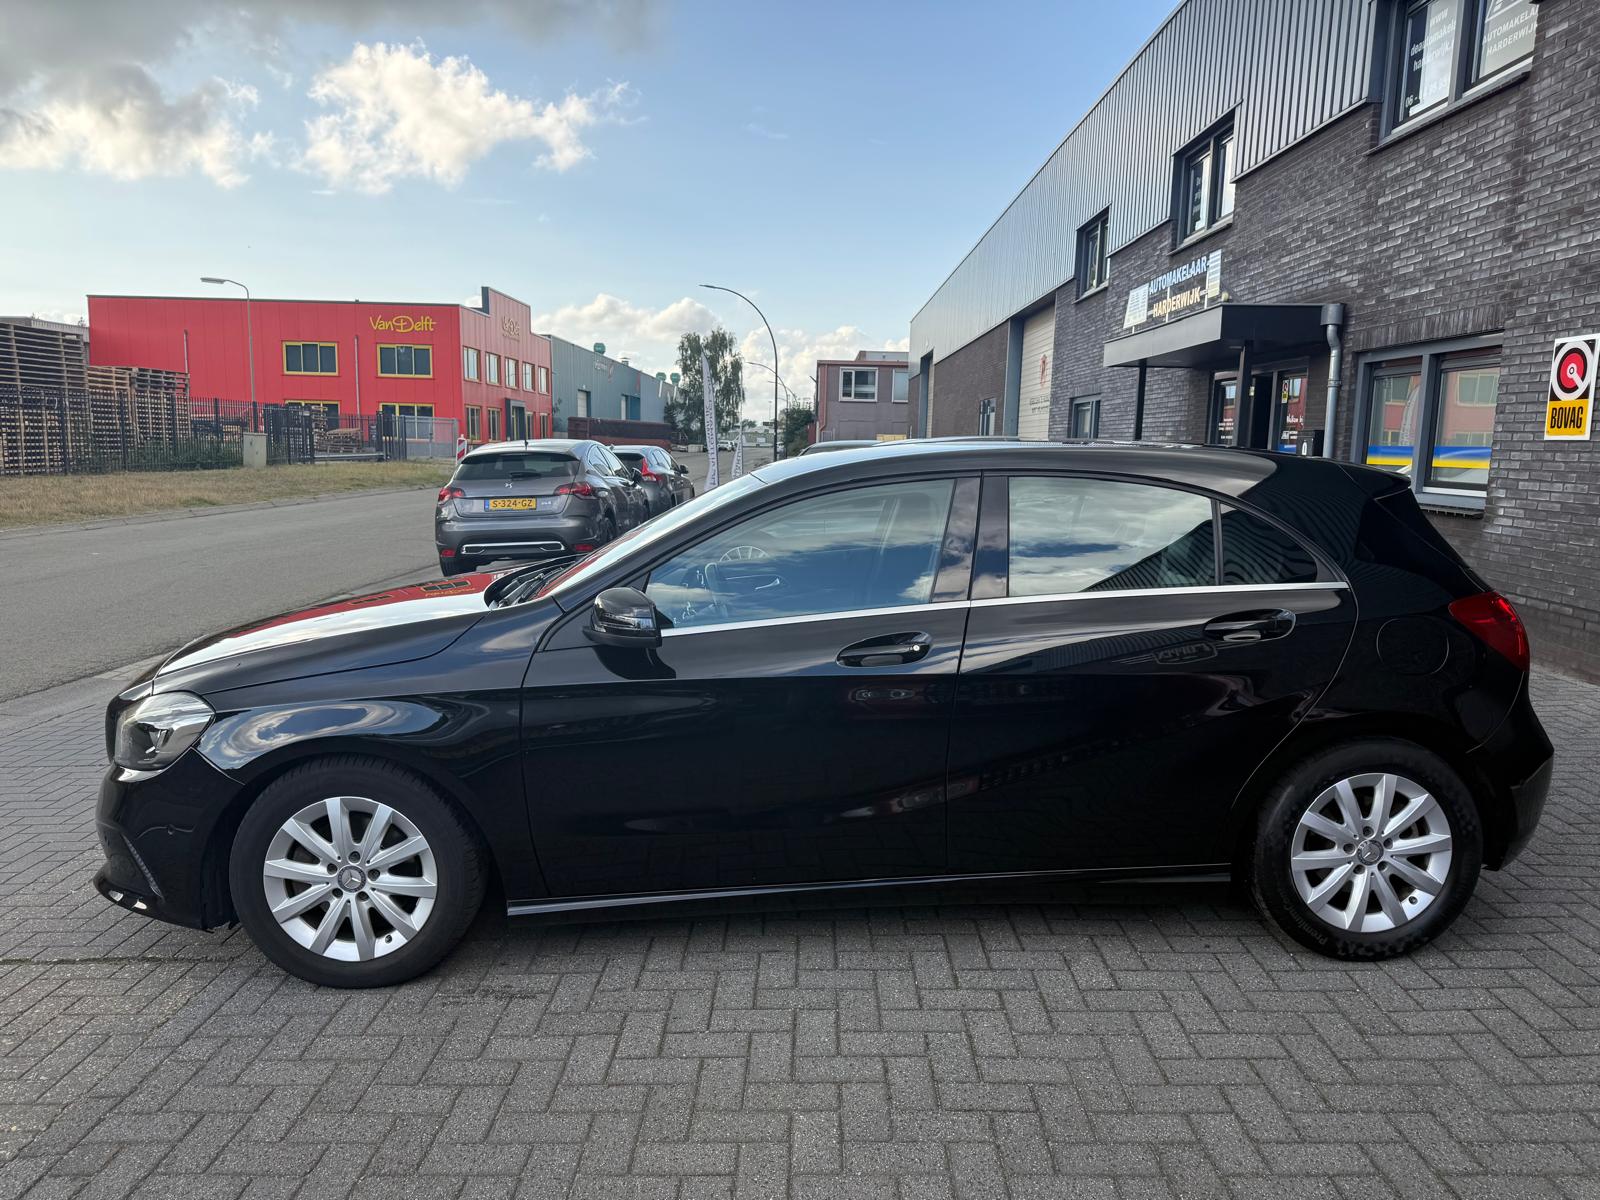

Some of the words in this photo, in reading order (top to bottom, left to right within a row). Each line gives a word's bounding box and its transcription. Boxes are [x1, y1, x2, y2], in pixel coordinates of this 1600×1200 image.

[1149, 255, 1207, 295] AUTOMAKELAAR
[1153, 286, 1201, 318] HARDERWIJK
[1550, 406, 1584, 429] BOVAG
[491, 499, 533, 508] S-324-GZ
